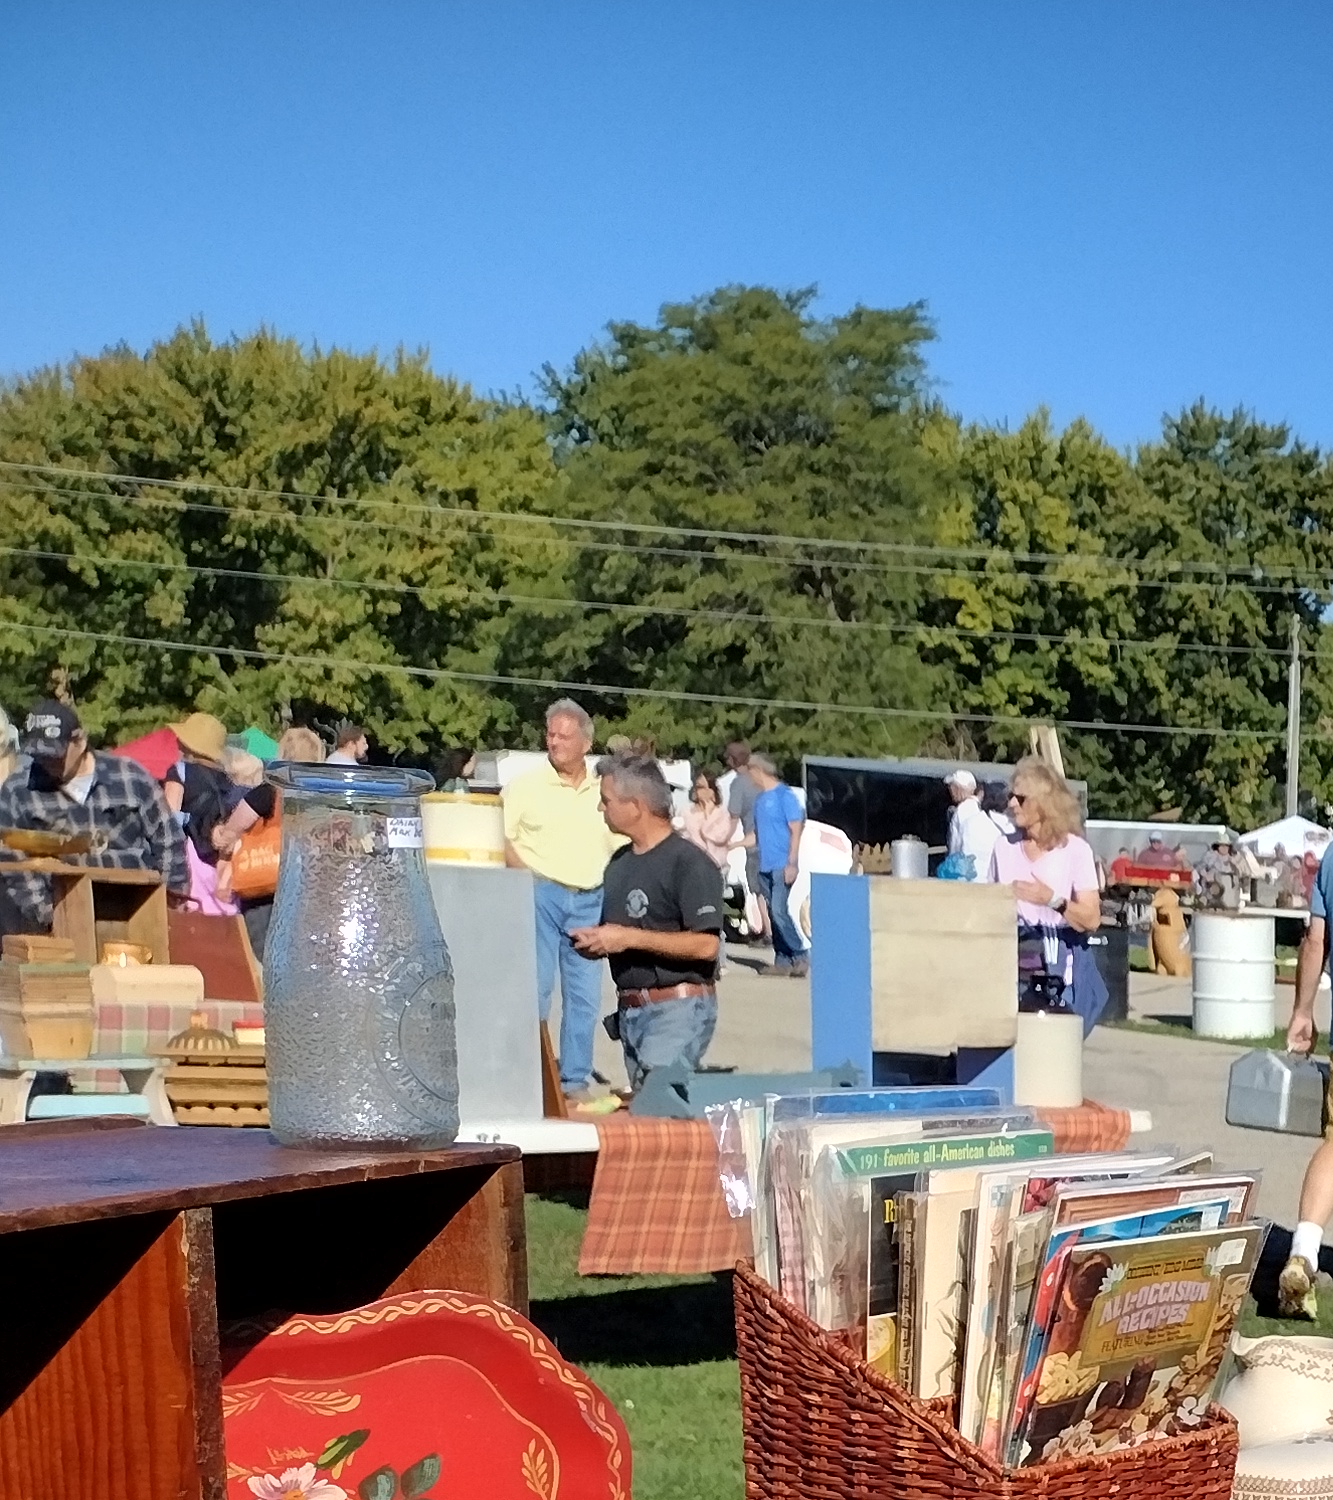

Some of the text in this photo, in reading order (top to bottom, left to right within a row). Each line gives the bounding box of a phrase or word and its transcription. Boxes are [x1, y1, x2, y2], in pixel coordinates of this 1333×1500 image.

[860, 1153, 878, 1169] 191
[883, 1147, 920, 1168] favorite
[923, 1143, 985, 1163] all-American
[987, 1139, 1016, 1158] dishes
[1100, 1281, 1209, 1326] ALL-OCCASION
[1117, 1303, 1191, 1335] RECIPES
